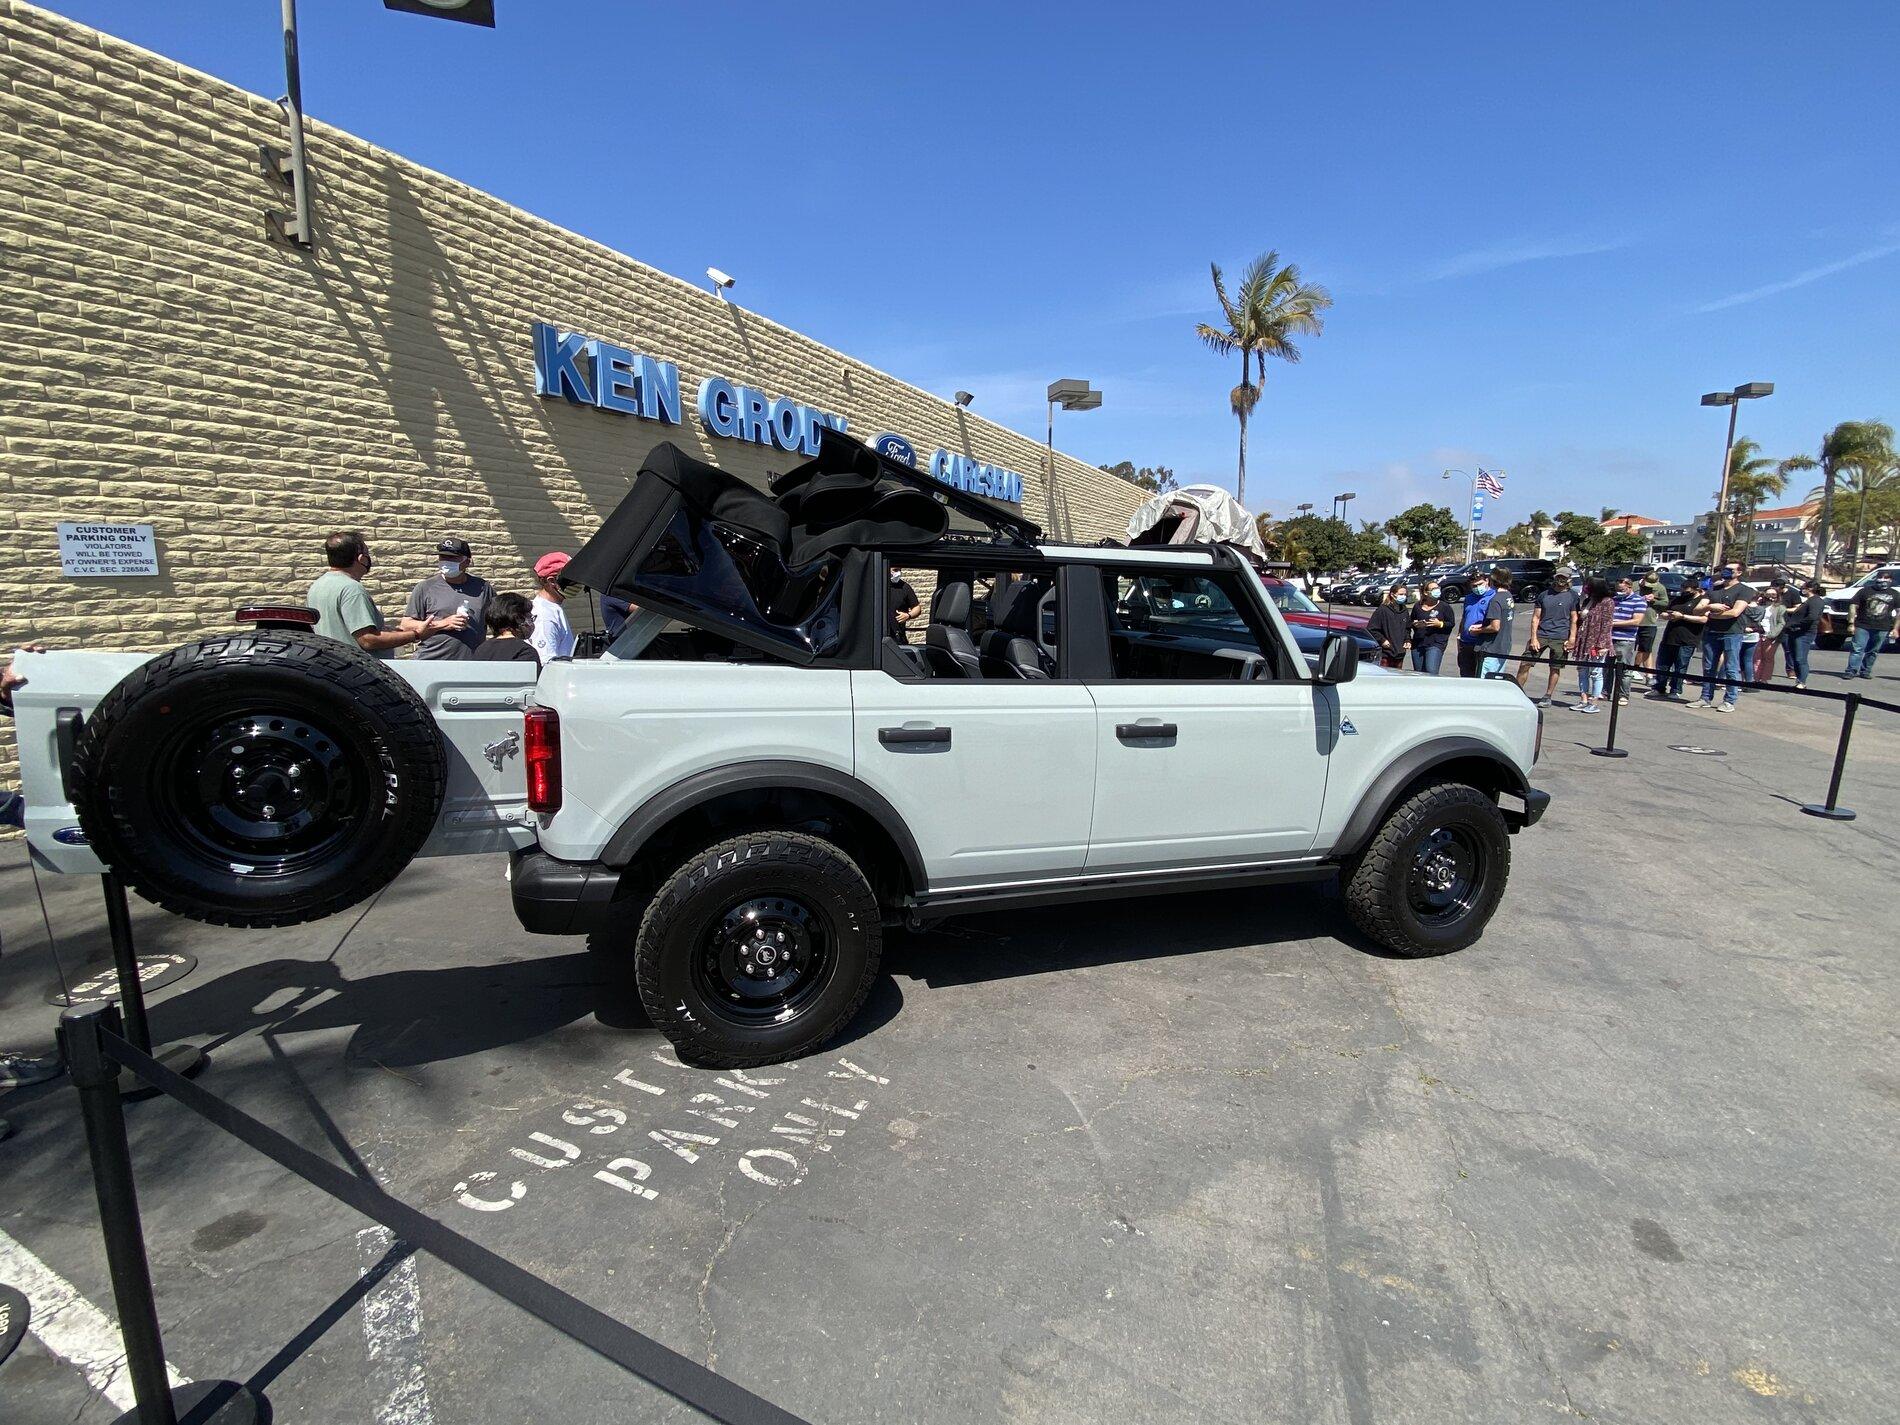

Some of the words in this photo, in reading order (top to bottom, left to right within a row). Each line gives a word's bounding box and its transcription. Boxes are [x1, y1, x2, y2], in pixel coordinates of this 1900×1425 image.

[531, 322, 682, 425] KEN
[929, 447, 1024, 503] CARLSBAD
[76, 526, 136, 534] CUSTOMER
[738, 1057, 890, 1188] ONLY
